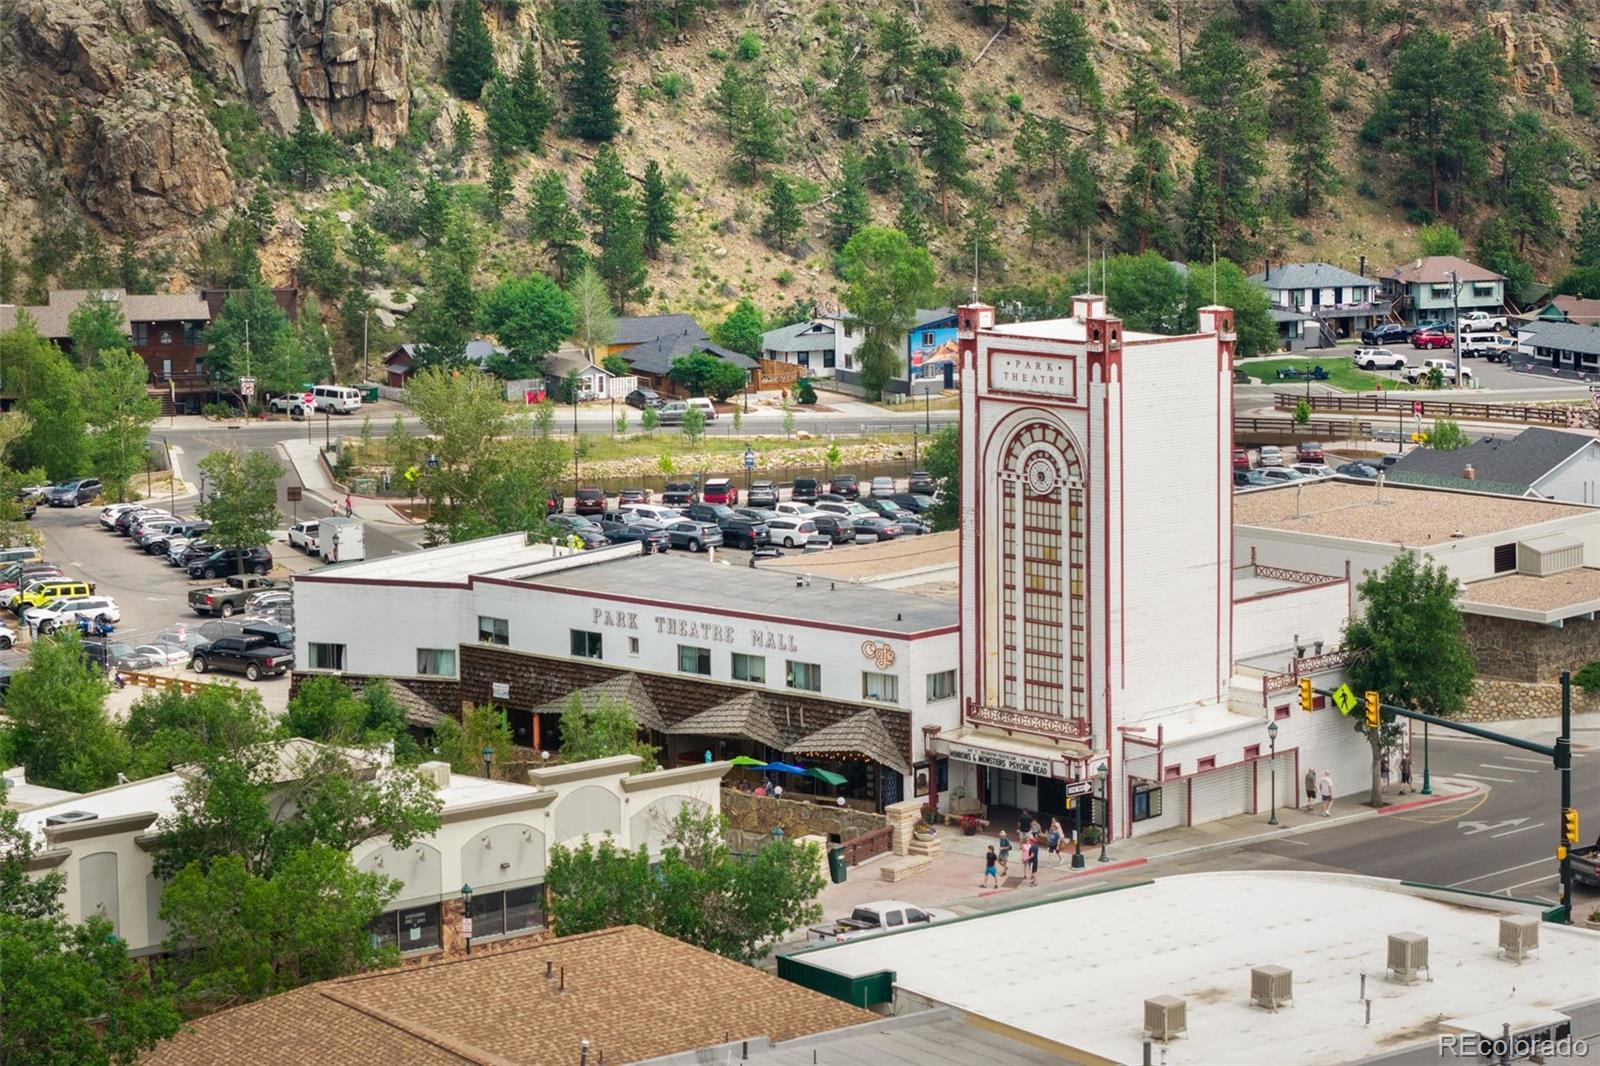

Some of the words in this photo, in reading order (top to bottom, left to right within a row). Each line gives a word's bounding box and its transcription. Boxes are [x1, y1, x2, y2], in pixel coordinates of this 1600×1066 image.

[1015, 360, 1053, 372] PARK
[1003, 371, 1065, 386] THEATRE
[592, 607, 638, 630] PARK
[655, 615, 735, 644] THEATRE
[751, 629, 798, 652] MALL
[861, 640, 896, 670] Cafe
[1008, 760, 1032, 772] PSYCHIC
[1033, 766, 1048, 775] READ
